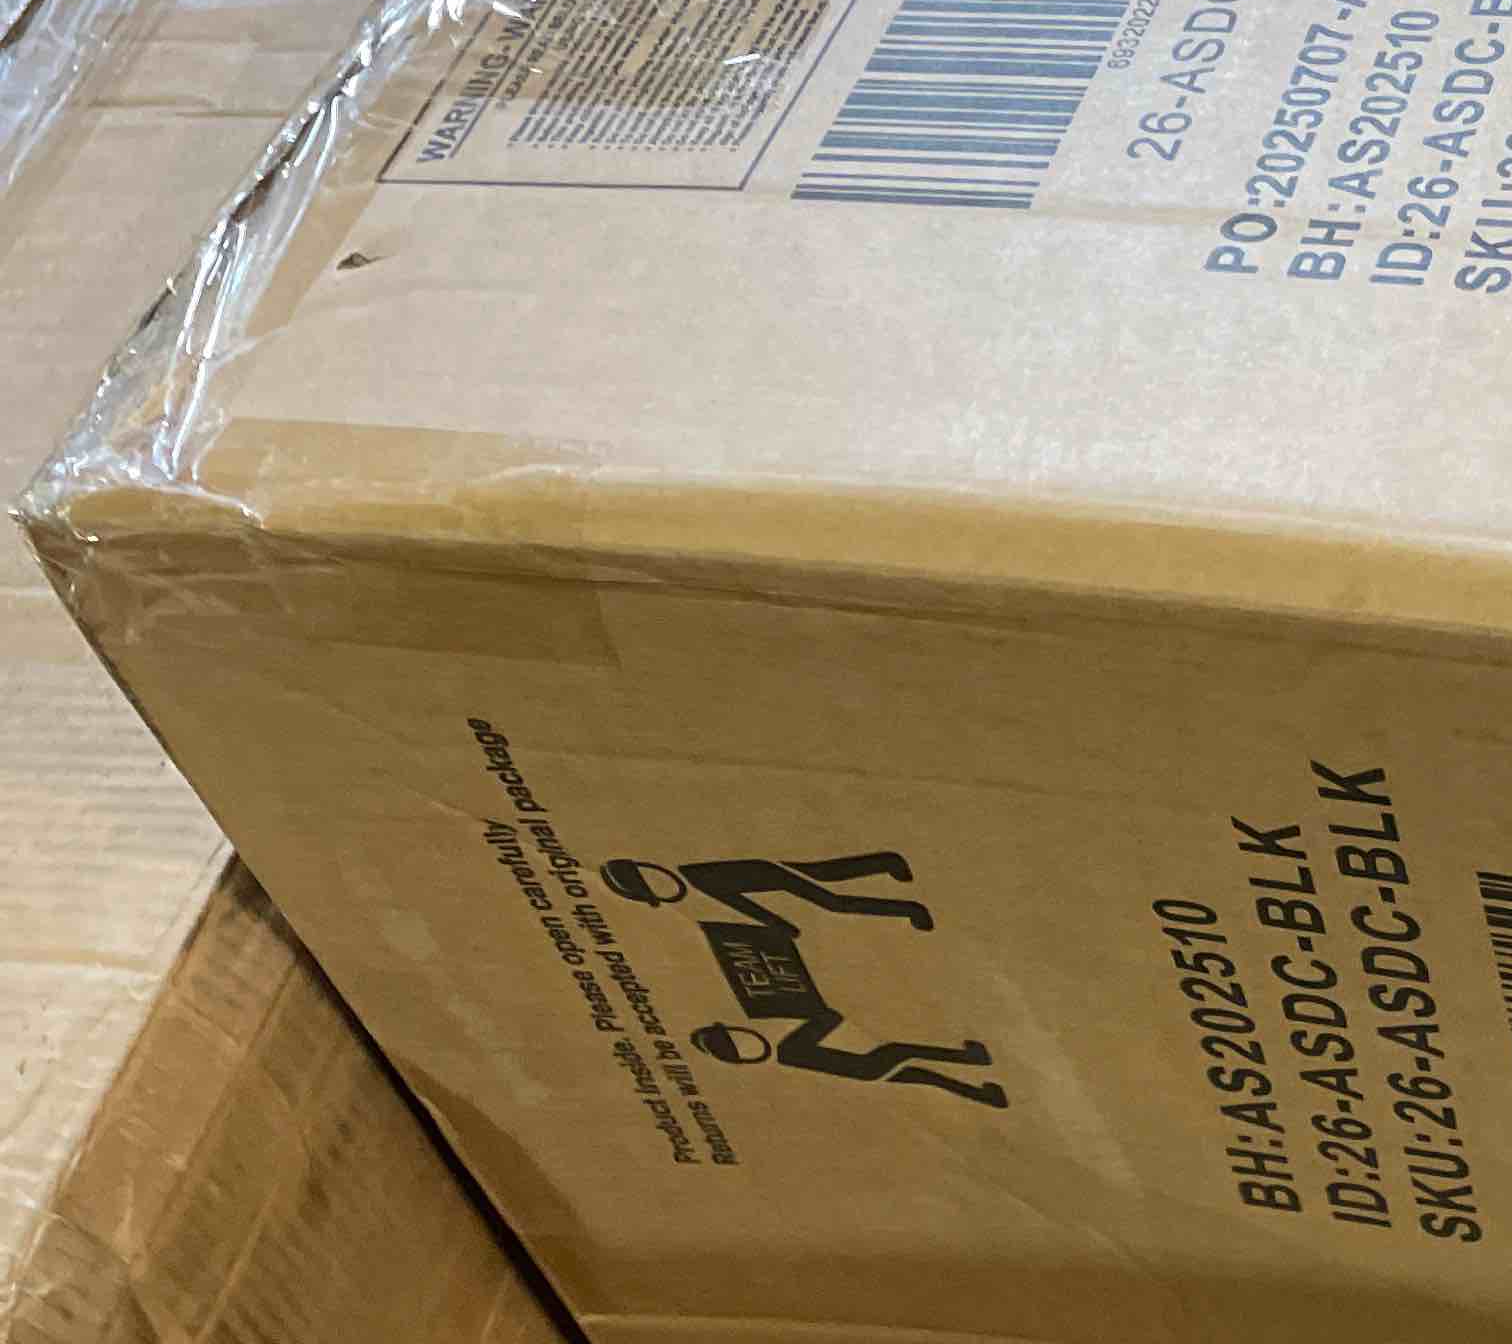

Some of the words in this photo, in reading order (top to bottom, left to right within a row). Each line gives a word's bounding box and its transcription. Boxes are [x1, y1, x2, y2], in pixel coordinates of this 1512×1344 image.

[1288, 10, 1440, 281] BH:AS202510
[466, 717, 550, 813] package
[482, 816, 553, 911] carefully
[516, 818, 589, 899] original
[540, 914, 586, 966] open
[570, 903, 617, 946] with
[572, 969, 625, 1032] Please
[594, 949, 667, 1037] accepted
[720, 940, 779, 996] TEAM
[758, 950, 803, 994] LIFT
[1230, 815, 1393, 1229] ID:26-ASDC-BLK
[1309, 759, 1484, 1245] SKU:26-ASDC-BLK
[653, 1038, 682, 1060] be
[662, 1063, 699, 1096] will
[1152, 897, 1302, 1216] BH:AS202510
[642, 1098, 703, 1164] Product
[688, 1099, 742, 1165] Returns
